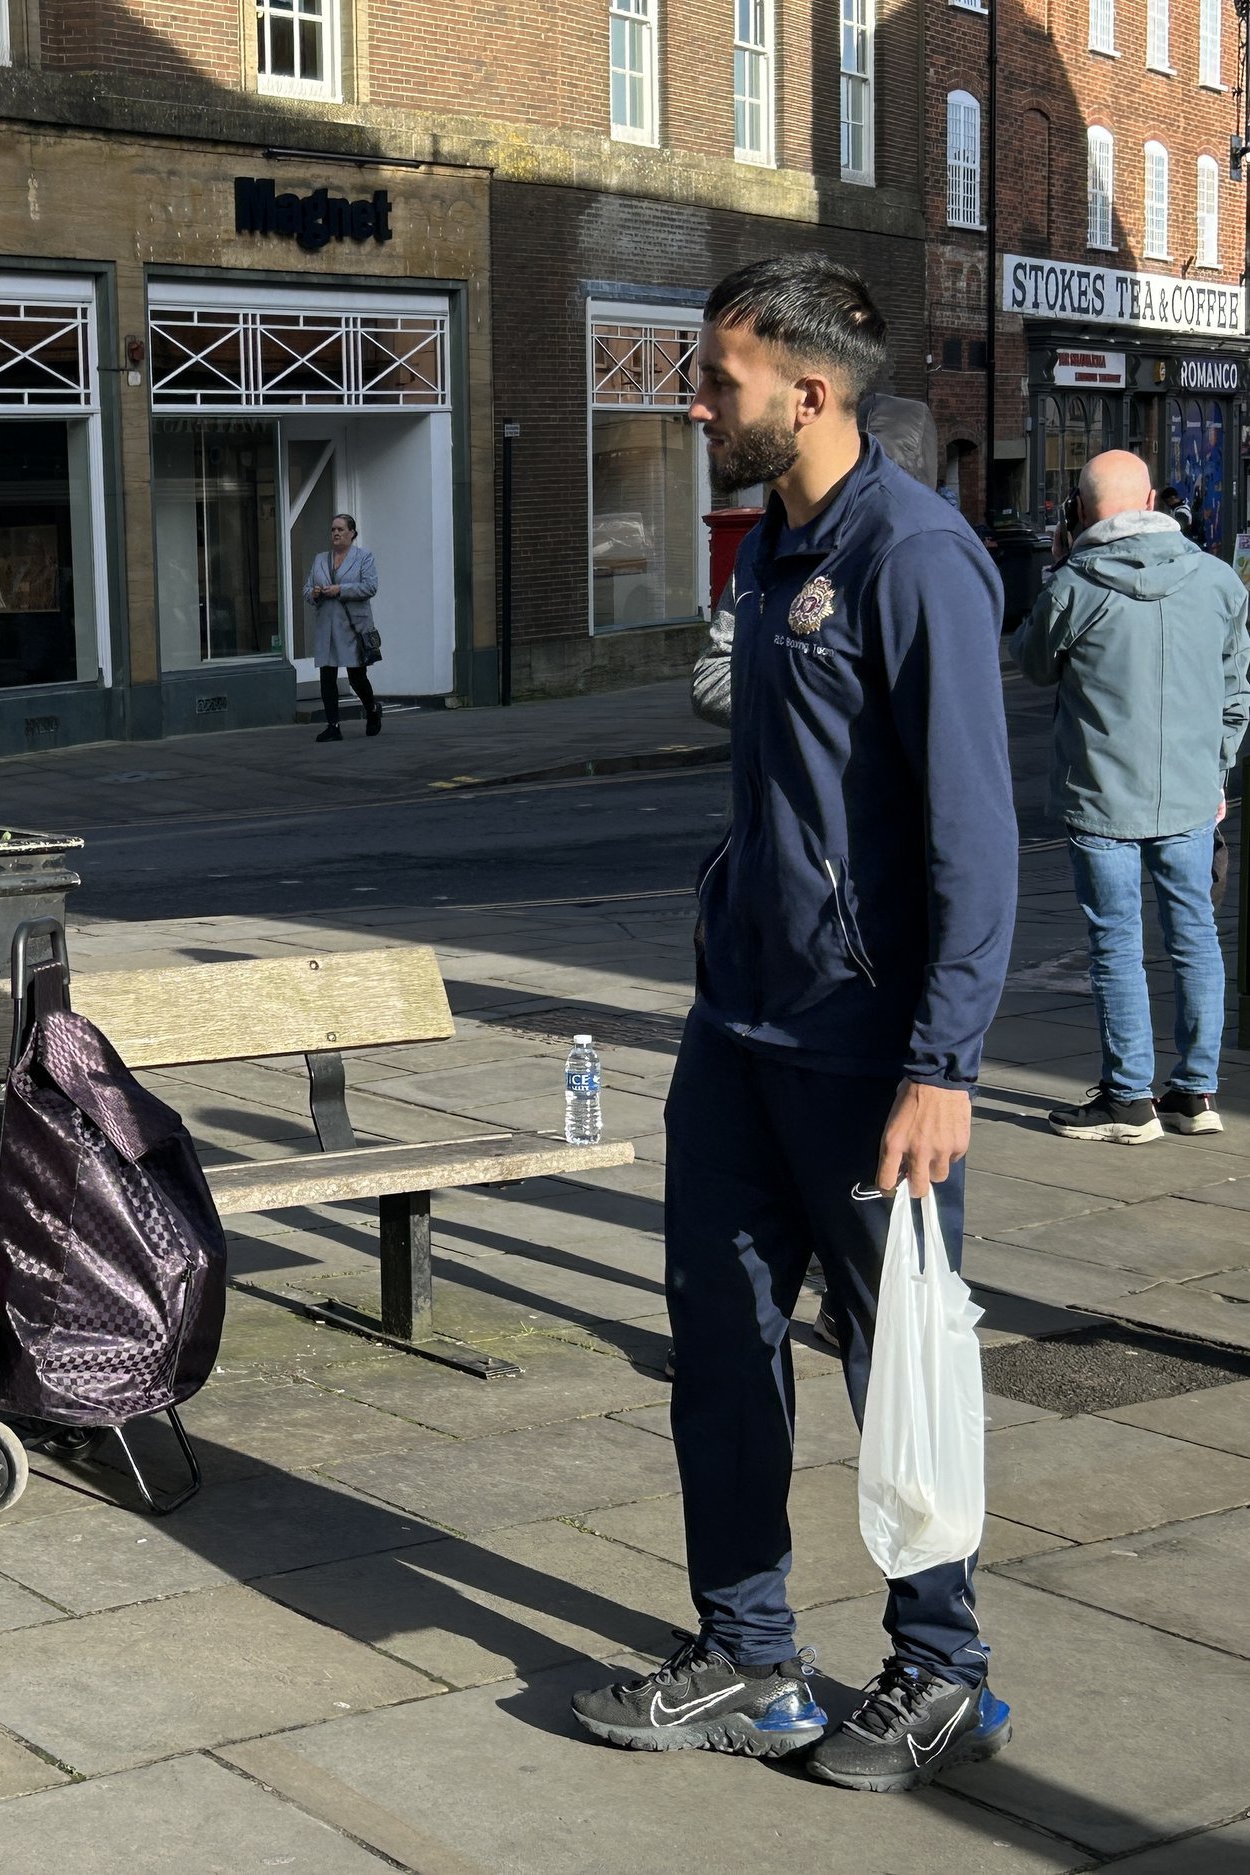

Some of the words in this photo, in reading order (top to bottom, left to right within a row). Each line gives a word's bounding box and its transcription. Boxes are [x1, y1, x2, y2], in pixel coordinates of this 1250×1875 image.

[235, 176, 392, 250] Magnet
[1012, 262, 1105, 316] STOKES
[1116, 276, 1156, 320] TEA
[1159, 288, 1168, 322] &
[1172, 284, 1238, 329] COFFEE
[1181, 361, 1237, 388] ROMANCO
